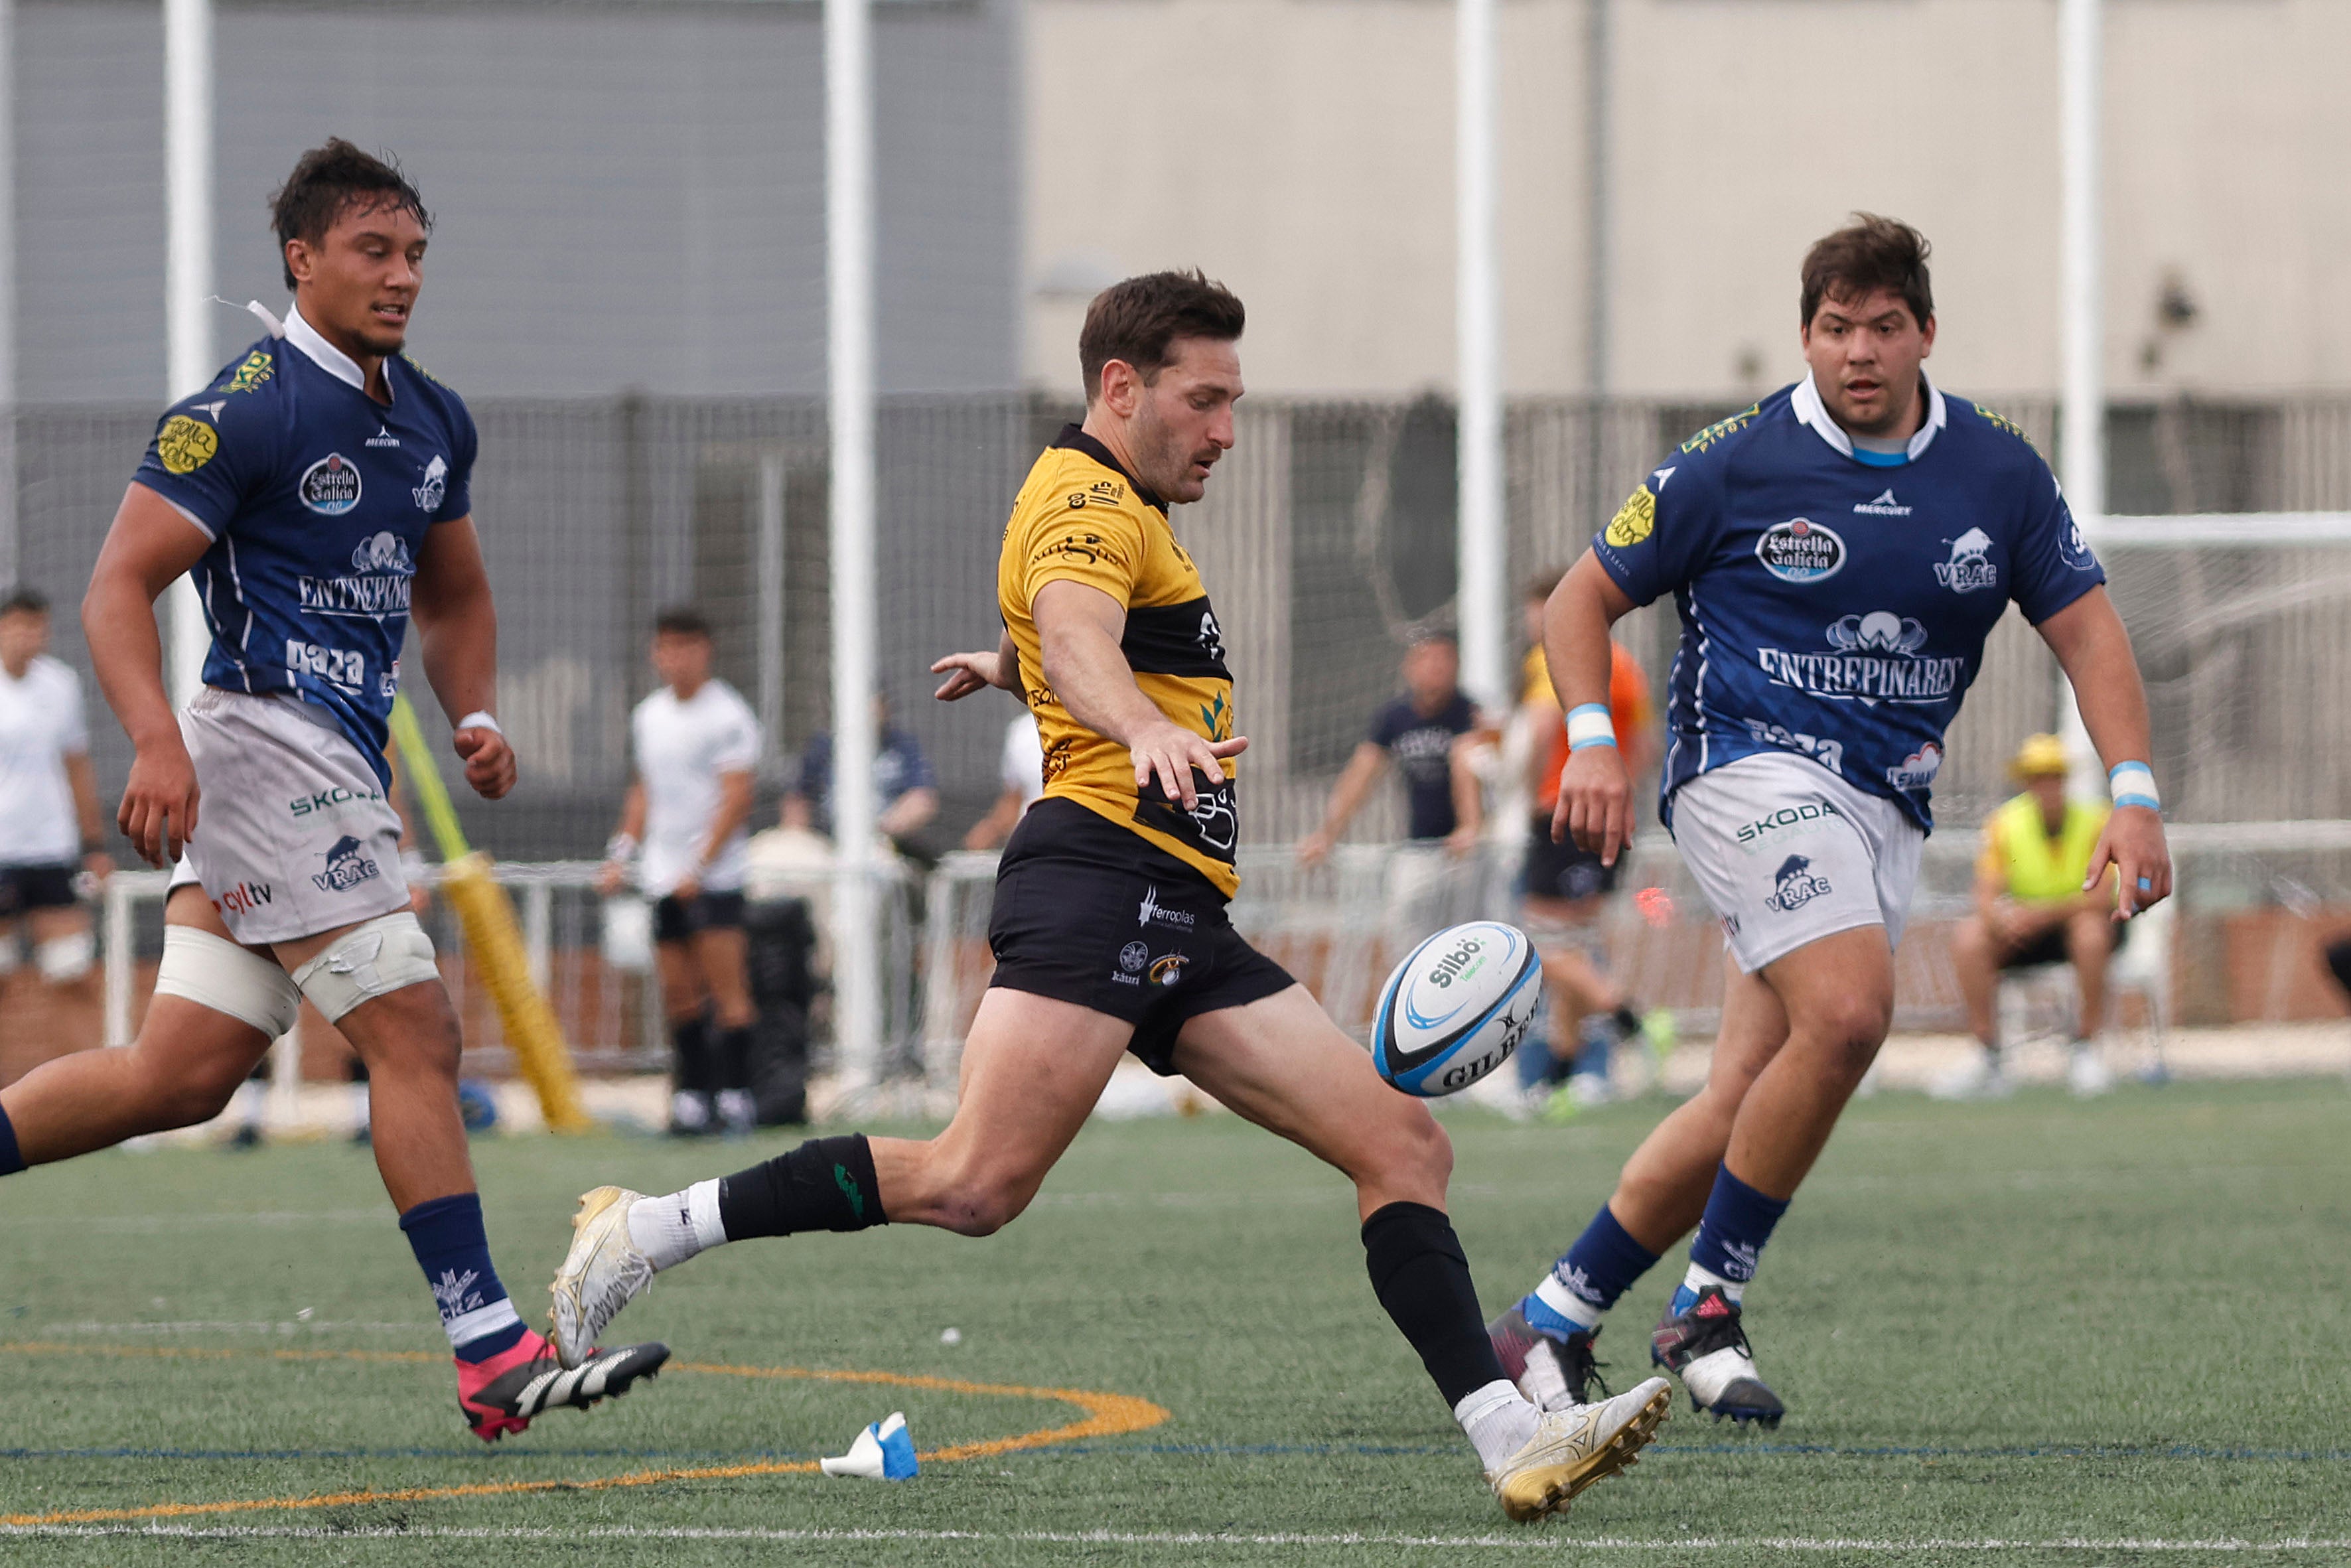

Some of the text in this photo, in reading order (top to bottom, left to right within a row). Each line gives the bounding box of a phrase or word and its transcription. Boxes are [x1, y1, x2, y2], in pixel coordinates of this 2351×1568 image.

[1699, 419, 1748, 454] PIVOT
[1853, 503, 1914, 516] MERCURY
[1768, 533, 1833, 553] Estrella
[1770, 550, 1829, 570] Galicia
[1932, 563, 1997, 587] VRAC
[1756, 647, 1964, 696] ENTREPINARES
[312, 859, 380, 892] VRAC
[1766, 877, 1832, 914] VRAC
[1152, 904, 1195, 925] ferroplas
